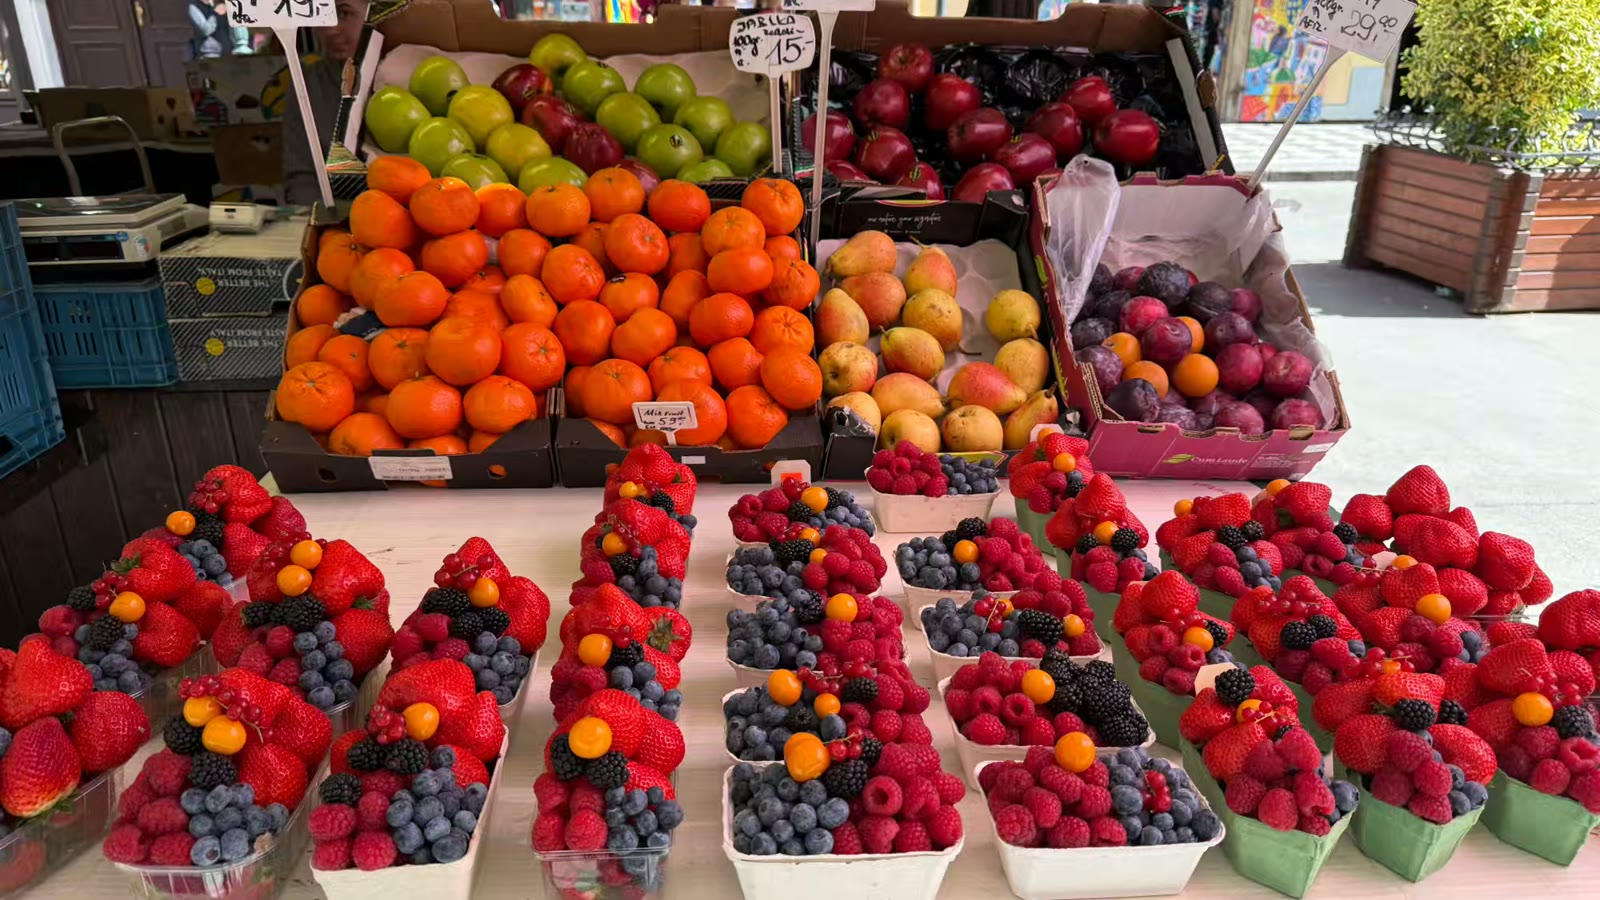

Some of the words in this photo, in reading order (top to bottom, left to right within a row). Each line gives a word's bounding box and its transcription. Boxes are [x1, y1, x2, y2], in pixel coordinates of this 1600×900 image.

[257, 268, 282, 276] TASTE
[217, 279, 251, 287] BETTER
[255, 279, 270, 287] THE
[266, 329, 285, 337] ASTE
[226, 339, 259, 347] BETTER
